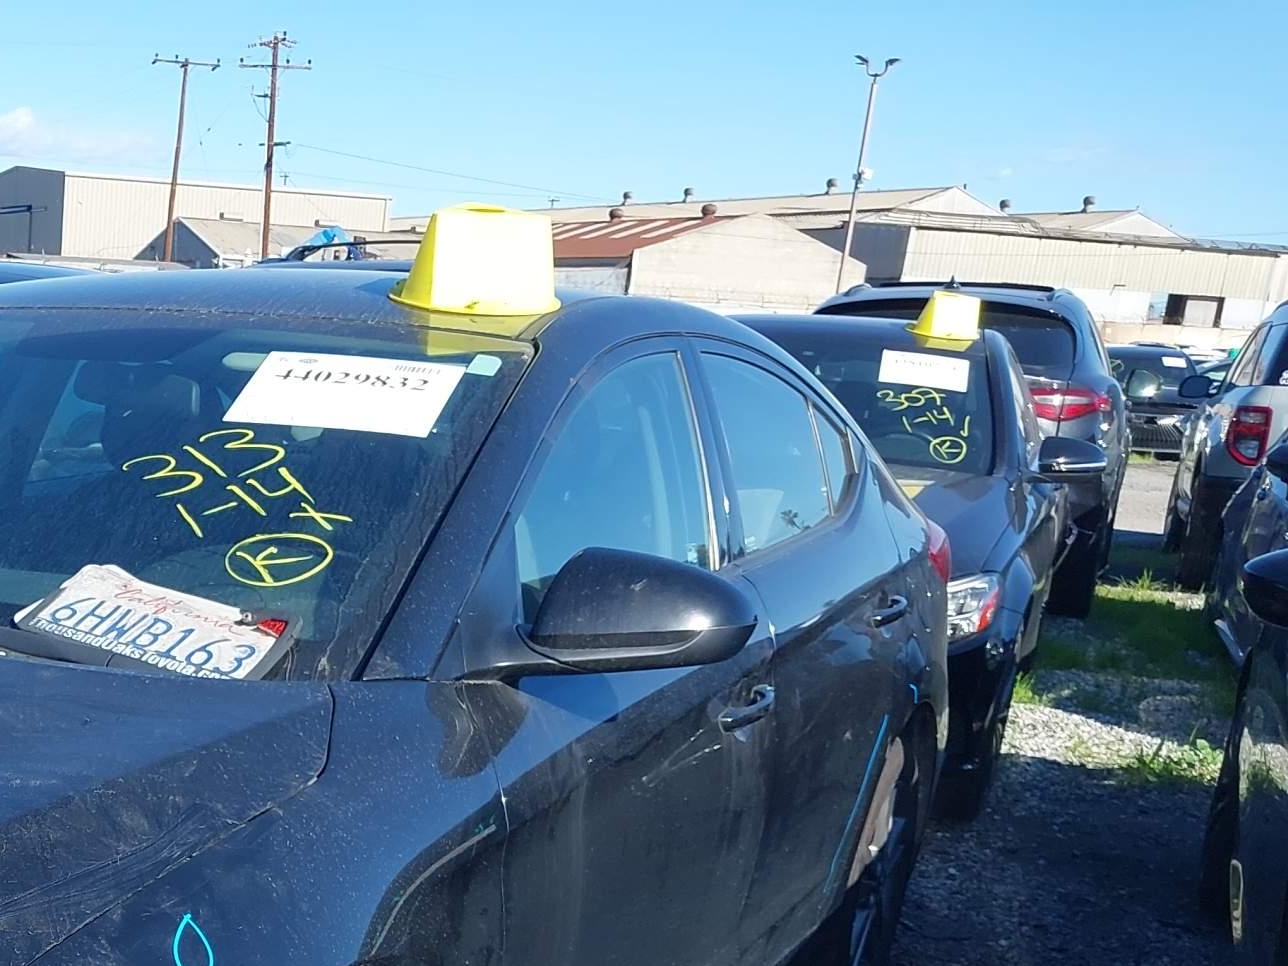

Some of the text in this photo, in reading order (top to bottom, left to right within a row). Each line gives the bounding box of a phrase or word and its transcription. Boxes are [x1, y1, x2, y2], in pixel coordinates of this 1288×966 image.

[275, 367, 429, 391] 44029832
[876, 387, 946, 411] 307
[901, 406, 954, 433] 1-14
[122, 429, 285, 498] 313
[176, 467, 316, 539] 1-14
[51, 597, 257, 675] 6HWB163
[114, 585, 246, 636] California
